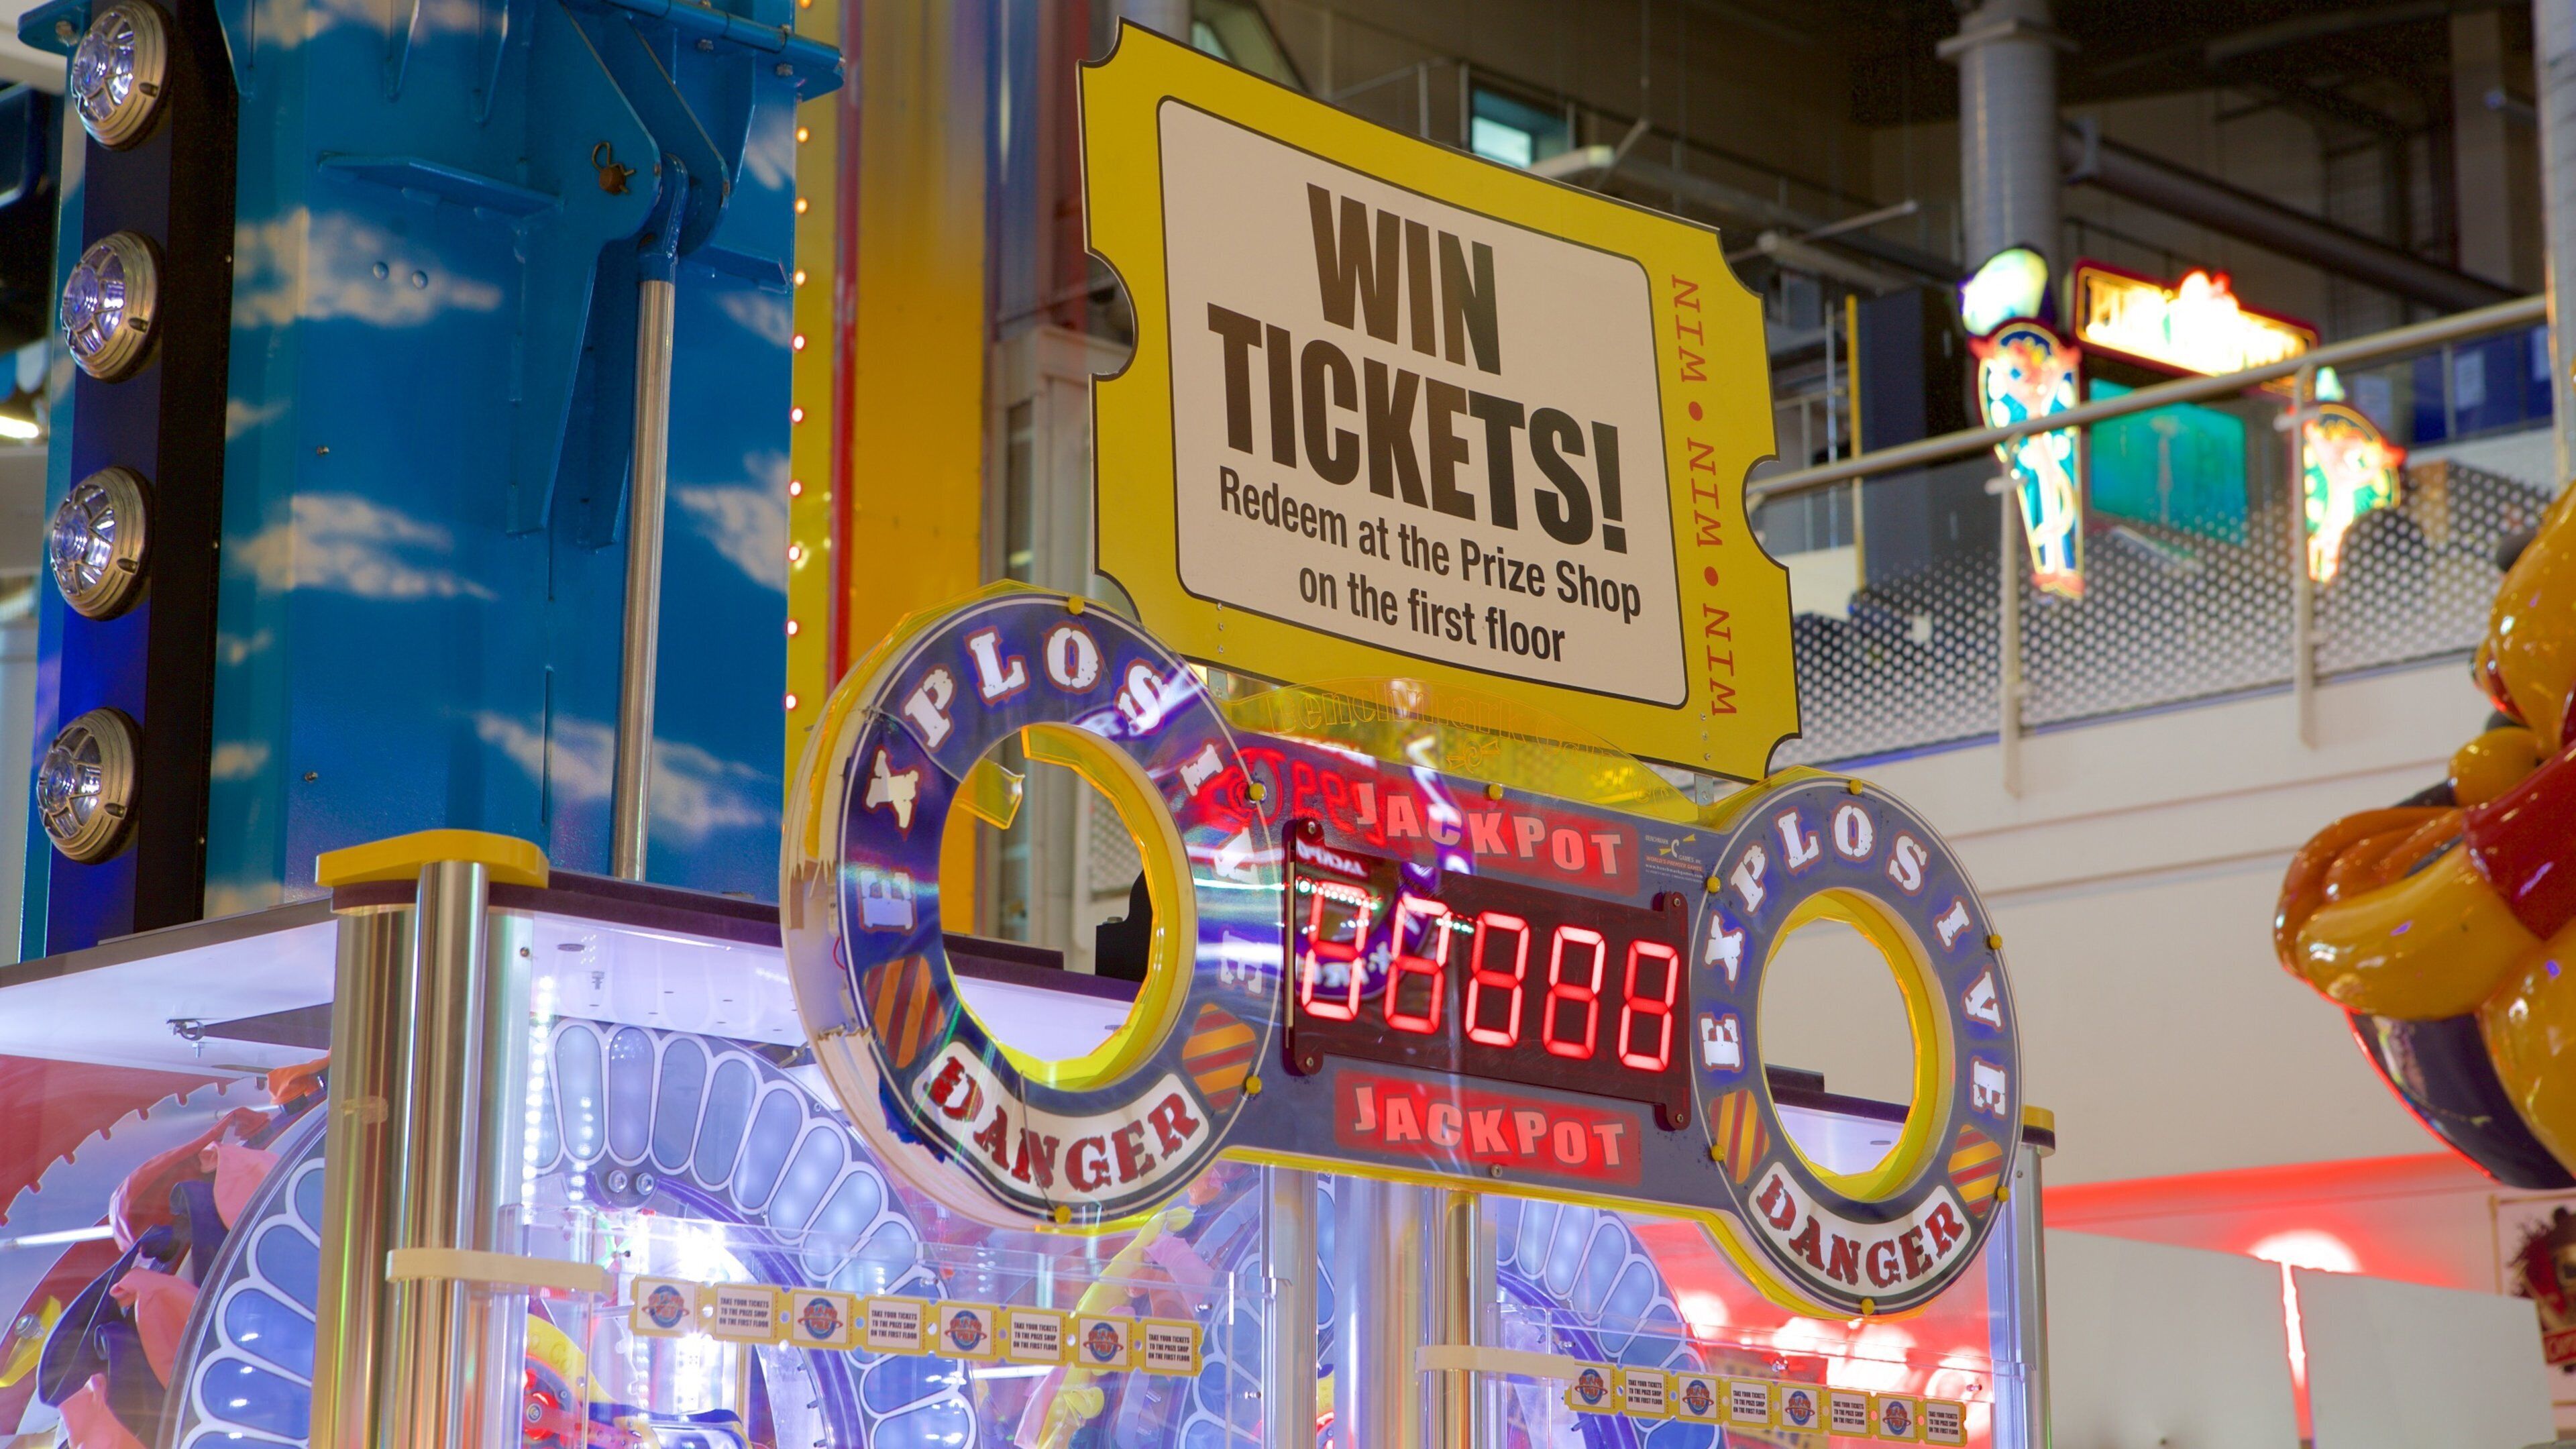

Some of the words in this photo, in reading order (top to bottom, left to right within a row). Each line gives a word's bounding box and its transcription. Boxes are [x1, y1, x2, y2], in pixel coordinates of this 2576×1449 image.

[1306, 182, 1501, 376] WIN
[1672, 274, 1707, 382] WIN
[1208, 303, 1627, 554] TICKETS!
[1687, 437, 1723, 547] WIN
[1220, 465, 1348, 548] Redeem
[1359, 517, 1390, 560] at
[1397, 523, 1450, 576] the
[1460, 538, 1545, 597] Prize
[1556, 560, 1641, 625] Shop
[1299, 568, 1338, 610] on
[1347, 572, 1397, 625] the
[1407, 588, 1477, 645] first
[1485, 606, 1566, 661] floor
[1703, 603, 1737, 716] WIN
[859, 627, 1265, 993] EXPLOSIVE
[1356, 782, 1622, 875] JACKPOT
[1701, 805, 2007, 1116] EXPLOSIVE
[929, 1056, 1201, 1193] DANGER
[1354, 1085, 1624, 1166] JACKPOT
[1756, 1173, 1967, 1289] DANGER
[720, 1297, 733, 1305] TAKE
[734, 1298, 747, 1307] YOUR
[748, 1299, 769, 1308] TICKETS
[727, 1318, 737, 1326] THE
[738, 1318, 752, 1327] FIRST
[753, 1320, 769, 1328] FLOOR
[729, 1308, 738, 1316] THE
[739, 1309, 753, 1317] PRIZE
[871, 1310, 883, 1318] TAKE
[884, 1311, 897, 1319] YOUR
[898, 1312, 917, 1320] TICKETS
[903, 1322, 916, 1330] SHOP
[1014, 1322, 1025, 1330] TAKE
[1038, 1324, 1057, 1332] TICKETS
[1043, 1343, 1057, 1351] FLOOR
[1172, 1336, 1190, 1344] TICKETS
